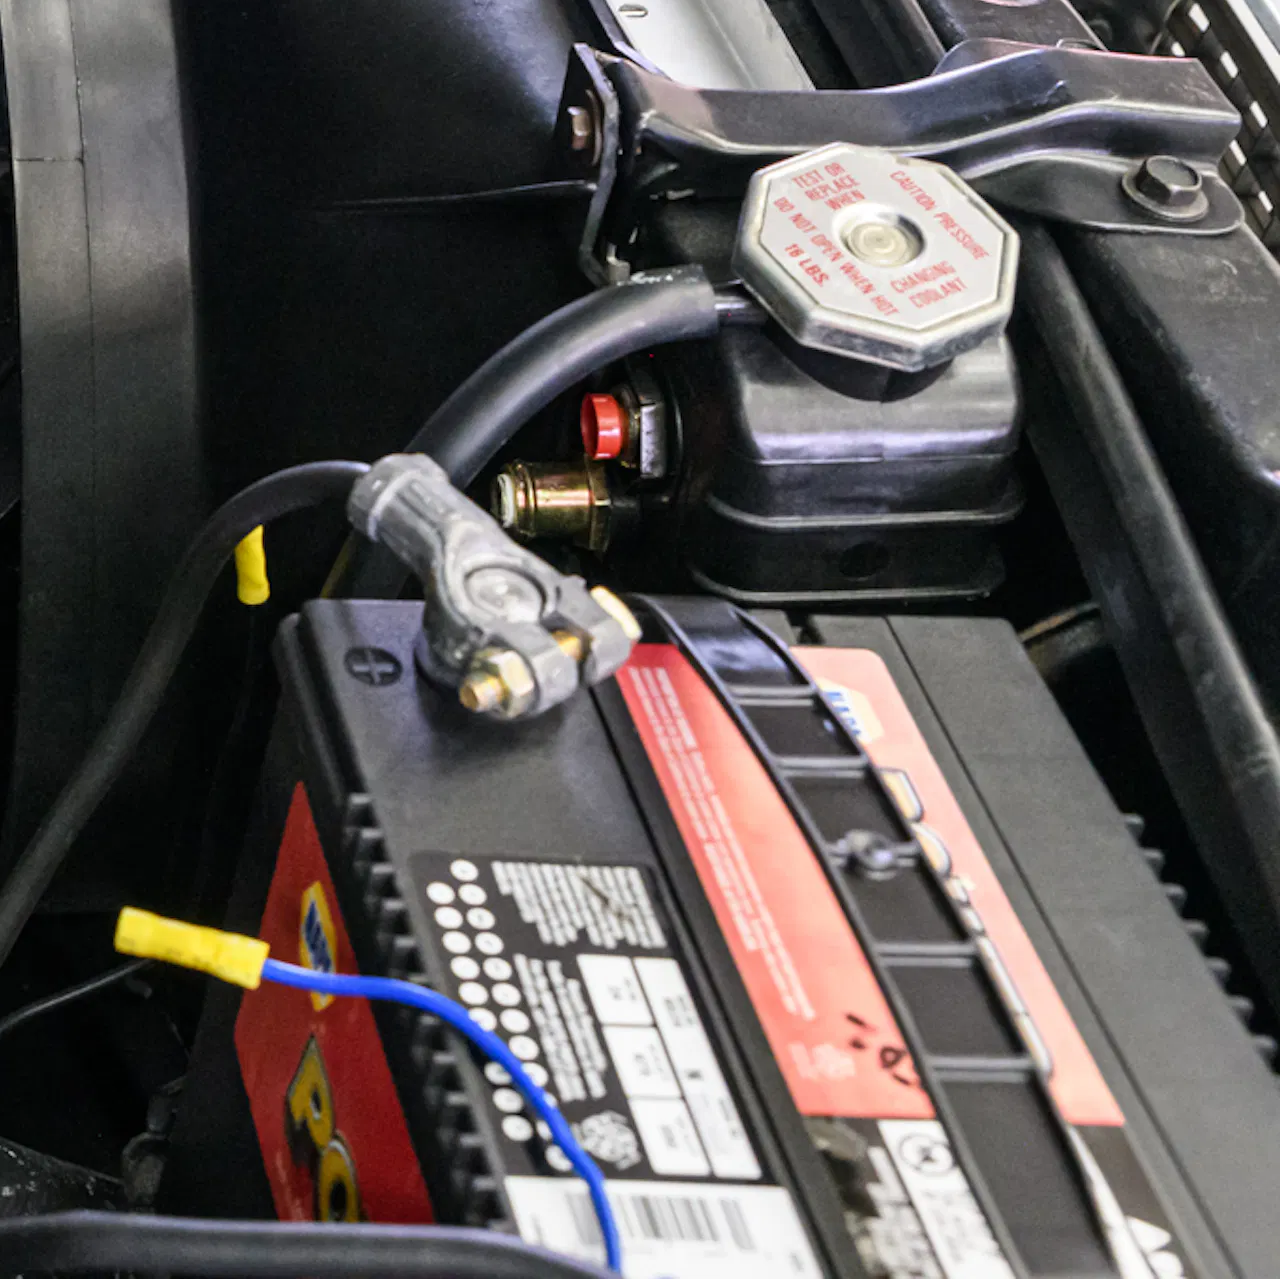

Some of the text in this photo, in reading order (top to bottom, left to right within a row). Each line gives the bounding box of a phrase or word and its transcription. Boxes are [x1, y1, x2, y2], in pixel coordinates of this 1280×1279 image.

[792, 162, 845, 188] TEST OR
[805, 175, 860, 201] REPLACE
[825, 190, 865, 211] WHEN
[890, 170, 989, 260] CAUTION PRESSURE
[789, 213, 817, 233] NOT
[810, 234, 844, 262] OPEN
[840, 262, 876, 294] WHEN
[871, 295, 899, 316] HOT
[890, 260, 957, 294] CHANGING
[908, 277, 967, 308] COOLANT
